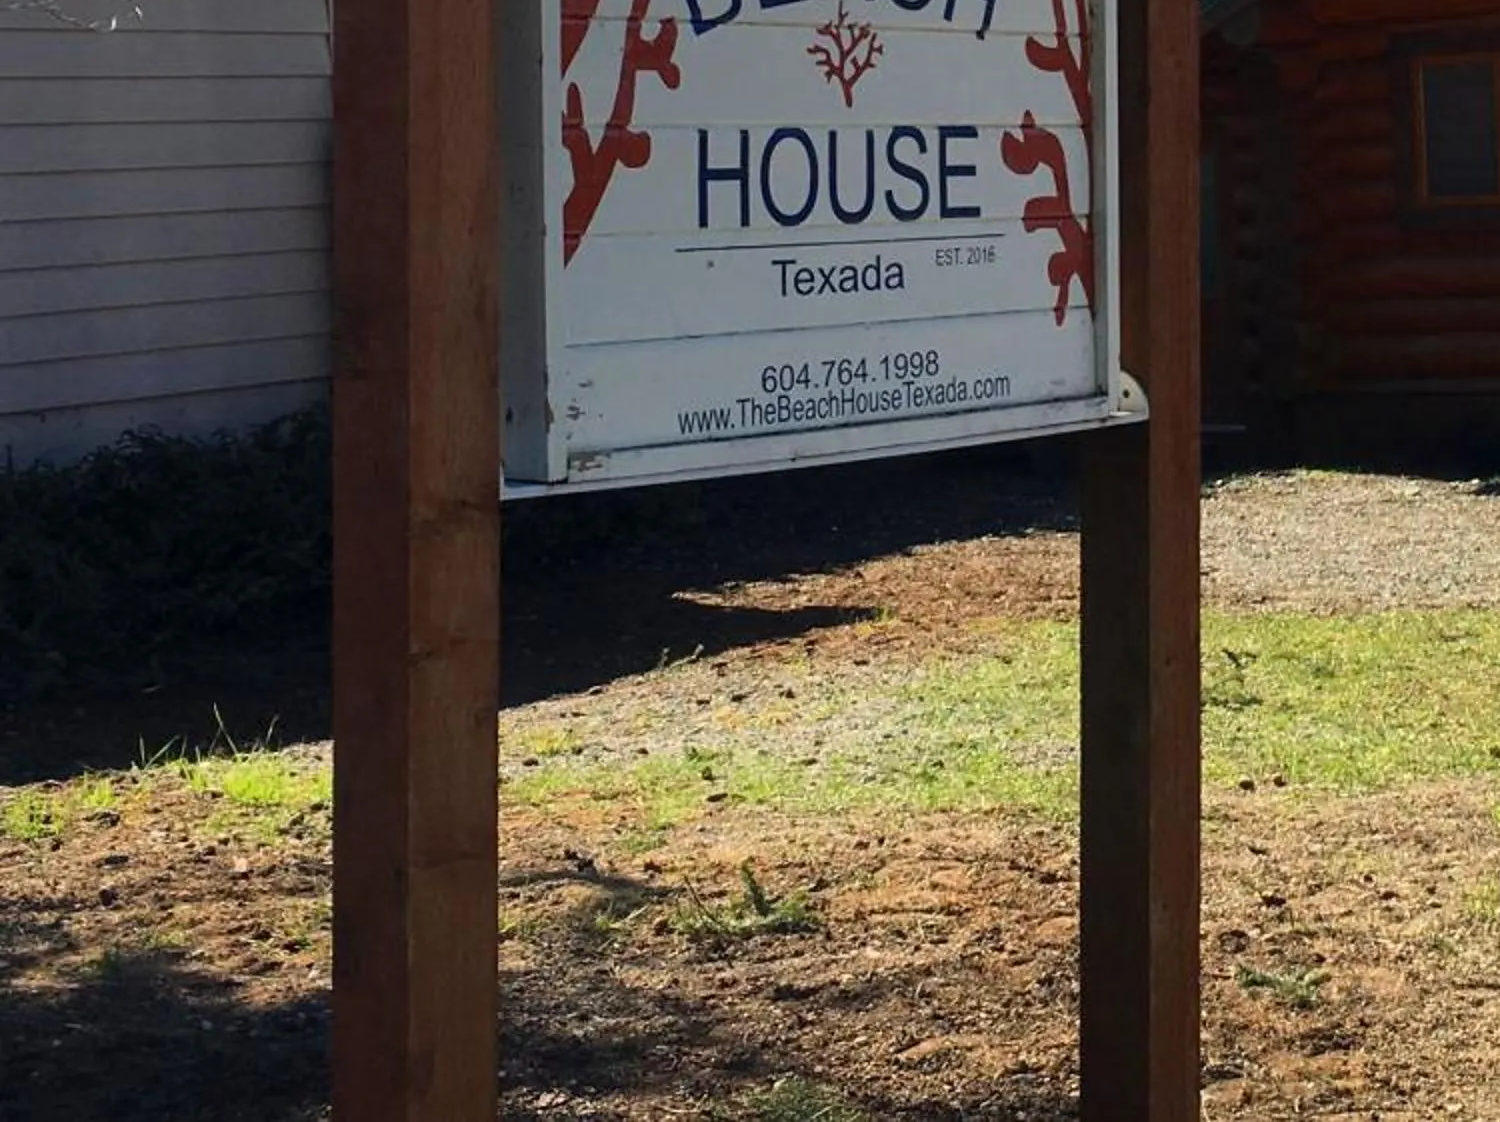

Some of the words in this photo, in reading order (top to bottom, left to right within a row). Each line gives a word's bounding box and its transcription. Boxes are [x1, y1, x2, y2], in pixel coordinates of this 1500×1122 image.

[697, 125, 982, 229] HOUSE
[771, 255, 905, 296] Texada
[935, 246, 964, 267] EST.
[966, 244, 997, 265] 2016
[760, 349, 940, 394] 604.764.1998
[677, 374, 1012, 436] www.TheBeachHouseTexada.com
